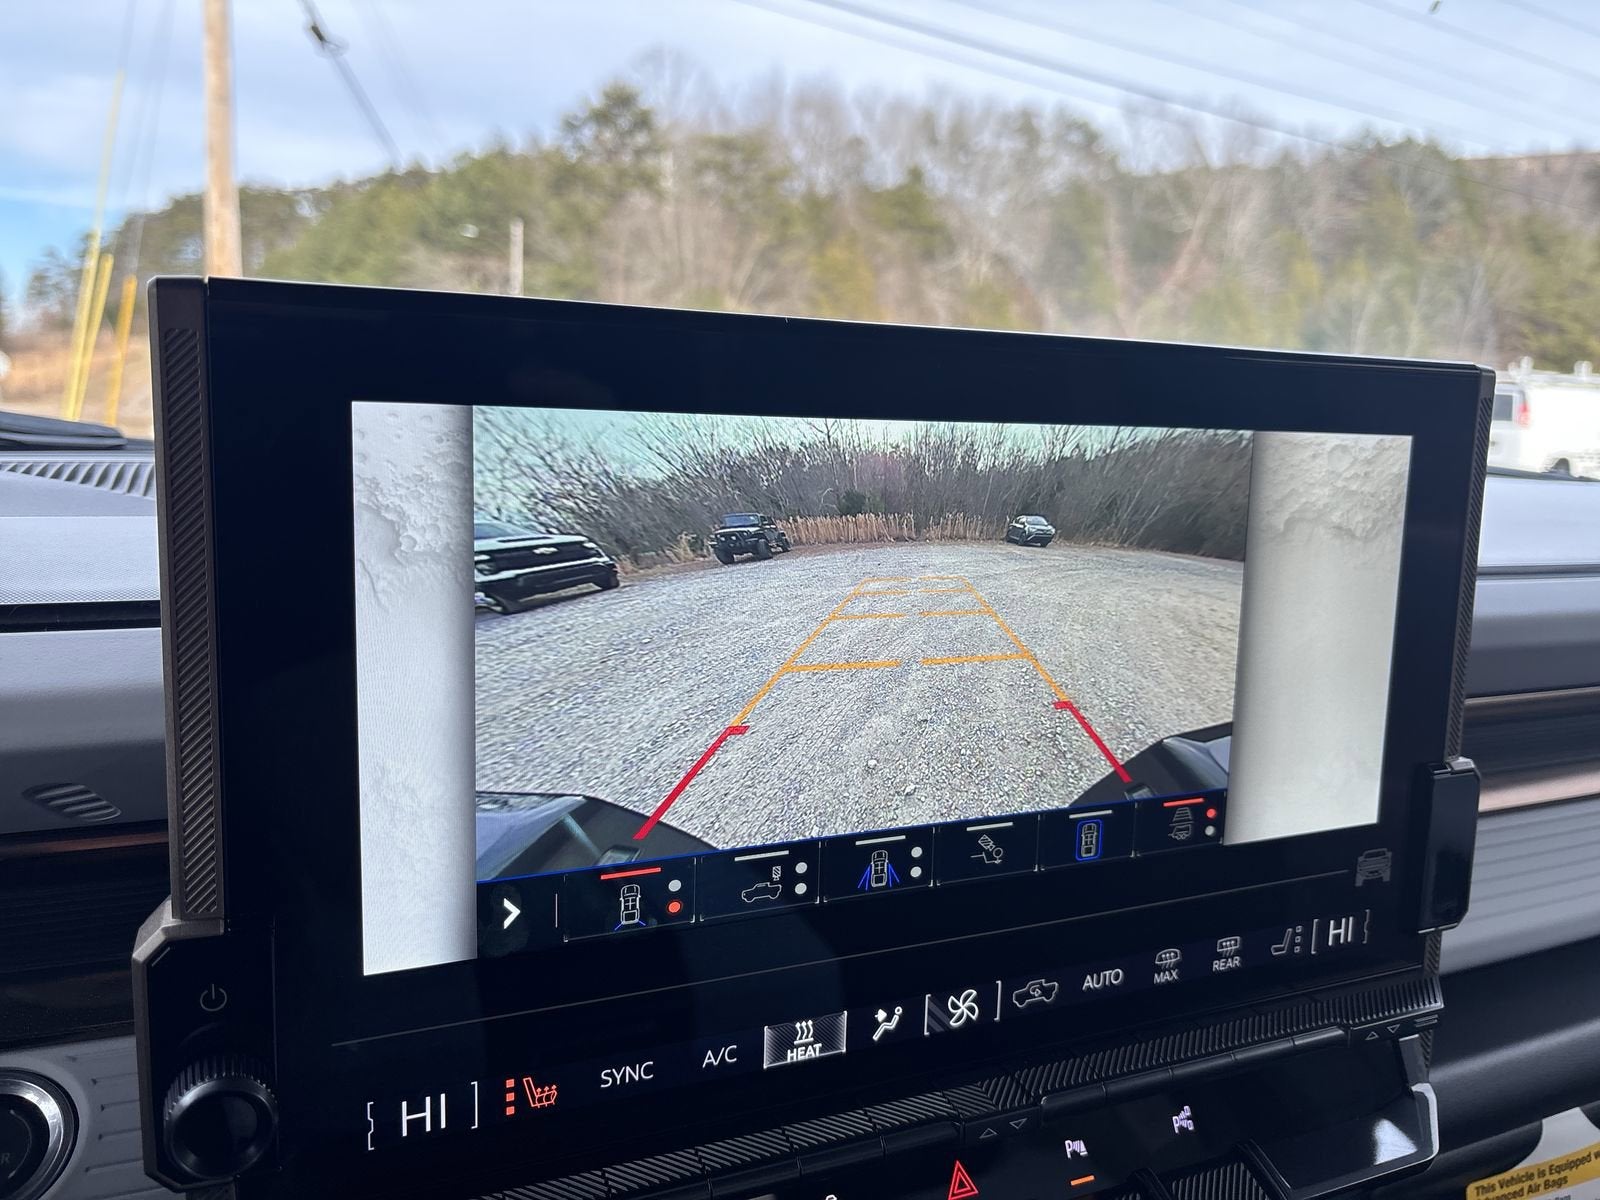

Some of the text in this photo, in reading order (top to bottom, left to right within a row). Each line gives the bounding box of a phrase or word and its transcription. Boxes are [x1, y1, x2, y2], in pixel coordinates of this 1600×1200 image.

[1328, 916, 1354, 946] HI
[1212, 955, 1241, 972] REAR
[1082, 968, 1124, 991] AUTO
[1153, 968, 1179, 985] MAX
[702, 1044, 738, 1069] A/C
[786, 1042, 823, 1063] HEAT
[600, 1061, 654, 1088] SYNC
[401, 1093, 446, 1137] HI
[1475, 1183, 1497, 1197] This
[1498, 1171, 1536, 1189] Vehicle
[1537, 1168, 1547, 1179] is
[1548, 1152, 1592, 1175] Equipped
[1526, 1181, 1541, 1195] Air
[1543, 1175, 1569, 1191] Bags
